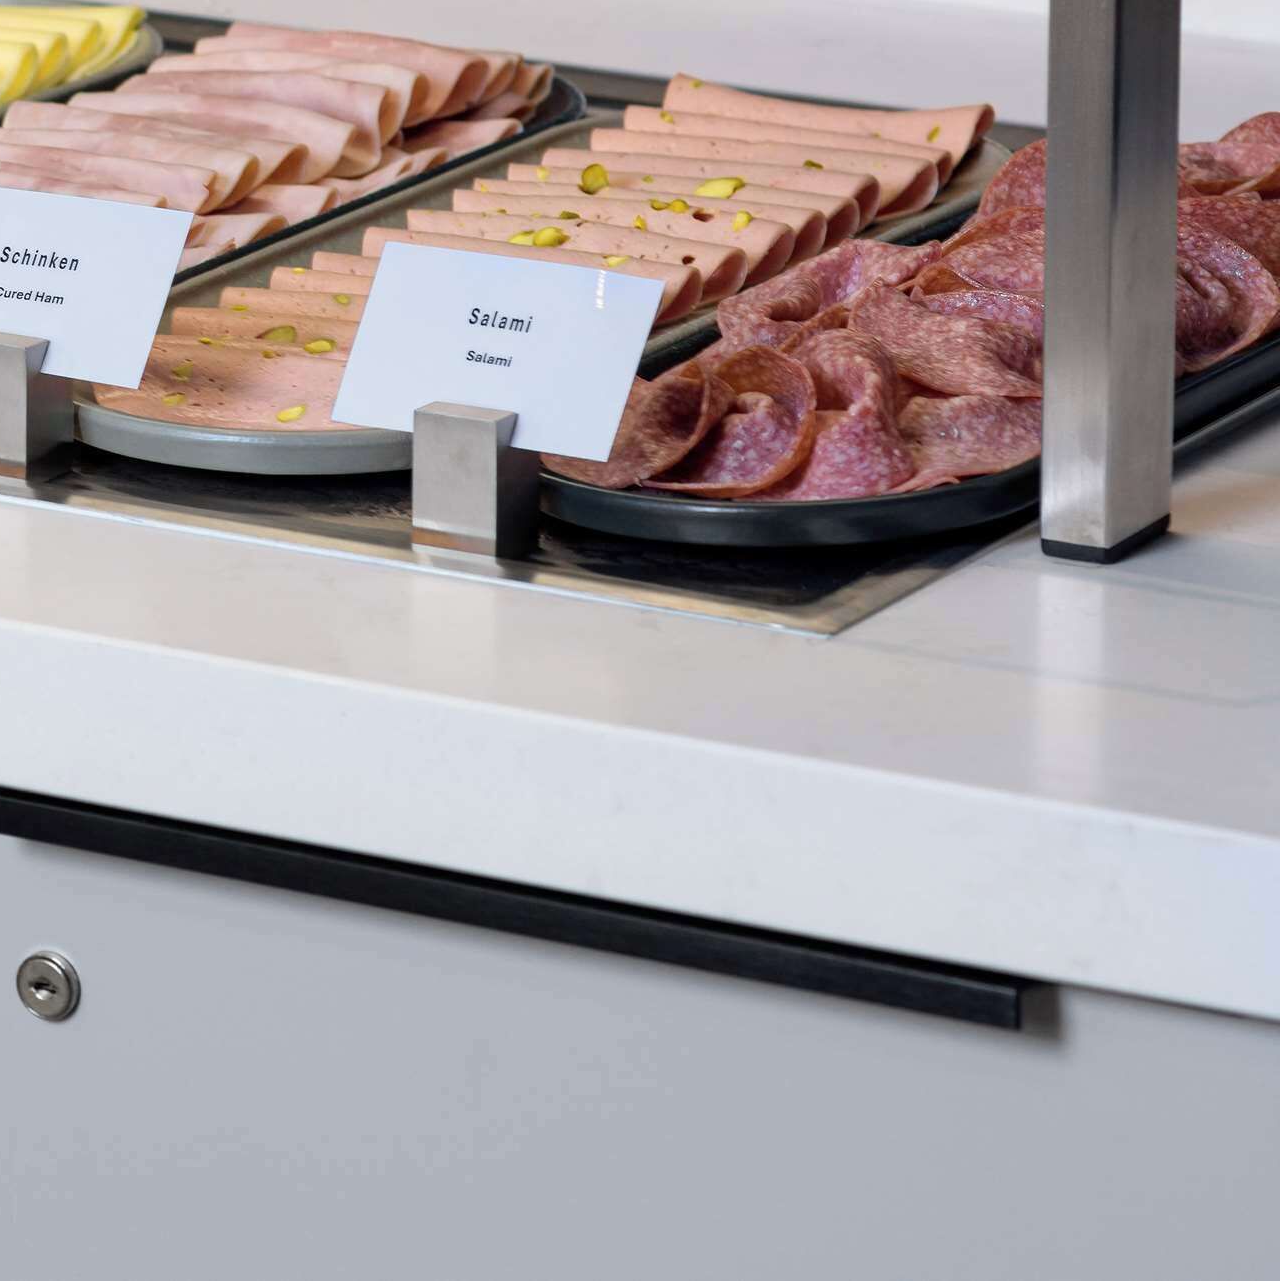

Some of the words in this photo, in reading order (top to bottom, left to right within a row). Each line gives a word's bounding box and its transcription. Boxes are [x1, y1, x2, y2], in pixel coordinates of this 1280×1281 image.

[0, 246, 79, 272] Schinken
[34, 291, 64, 305] Ham
[468, 307, 533, 333] Salami
[466, 350, 513, 368] Salami
